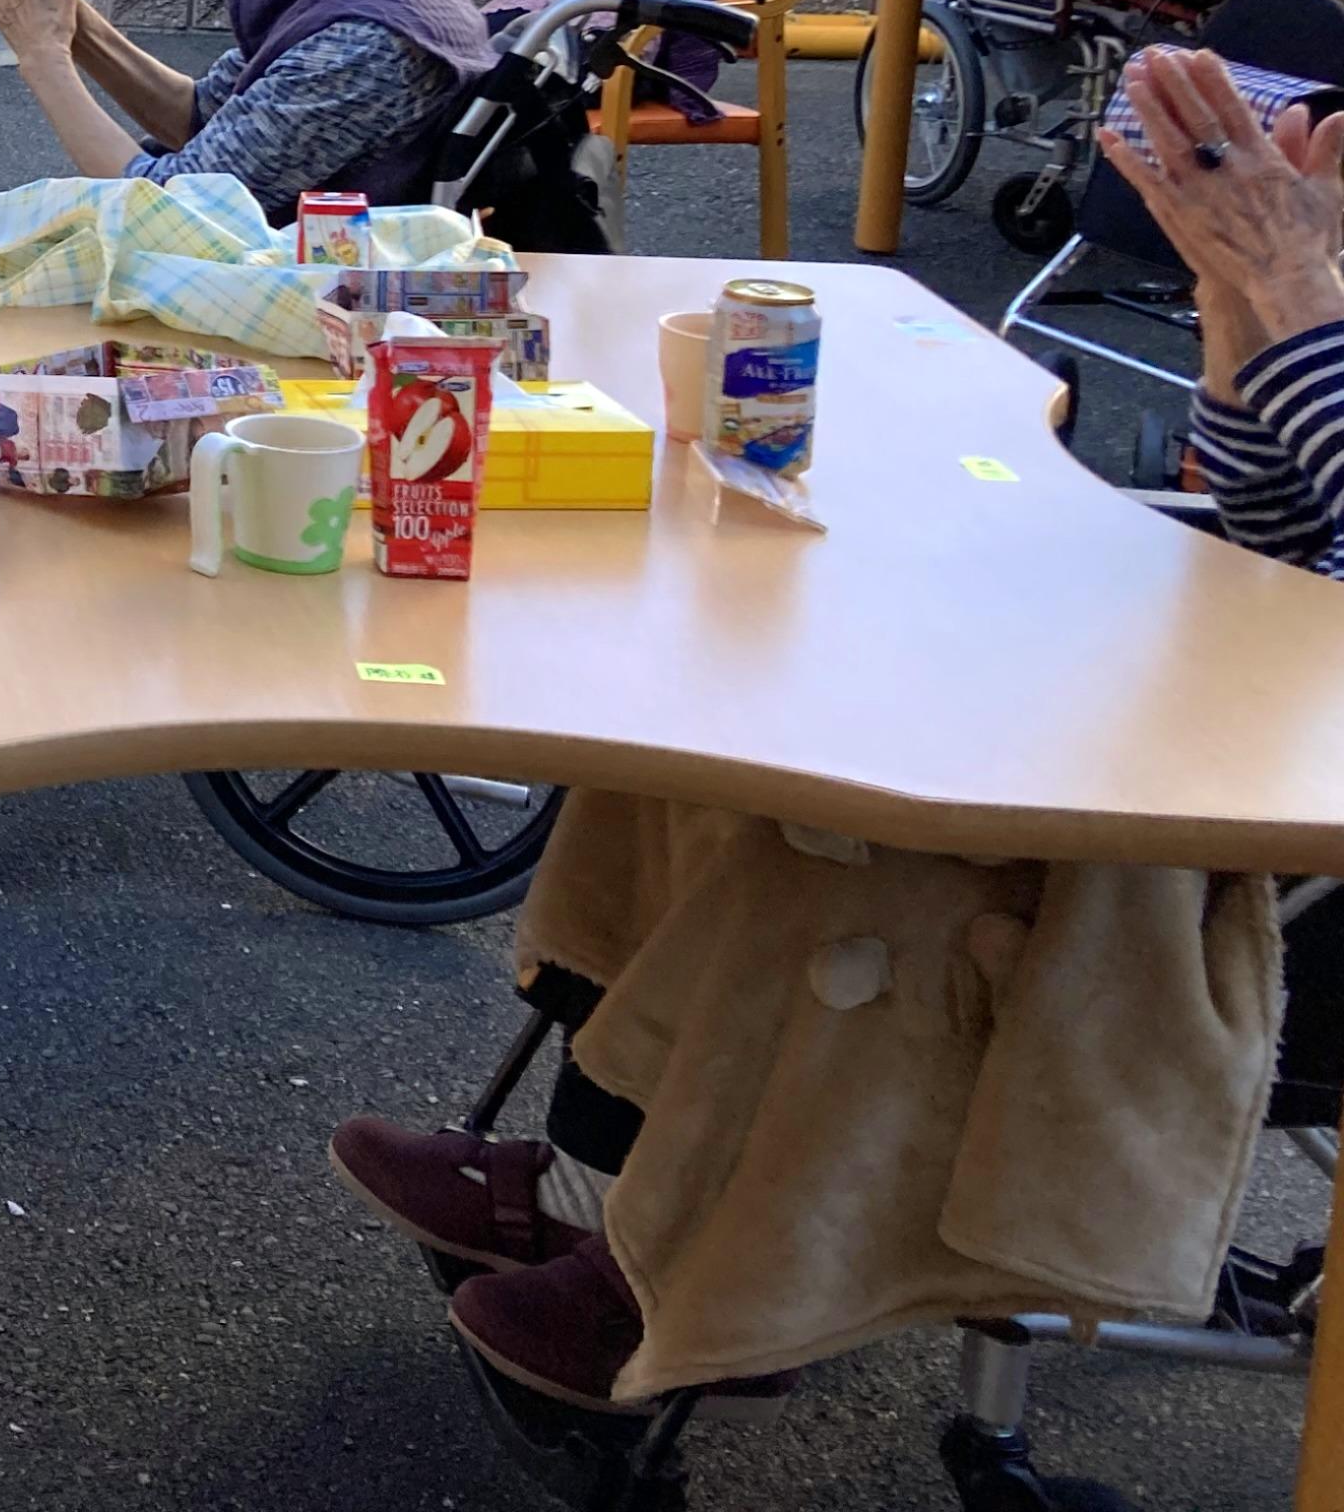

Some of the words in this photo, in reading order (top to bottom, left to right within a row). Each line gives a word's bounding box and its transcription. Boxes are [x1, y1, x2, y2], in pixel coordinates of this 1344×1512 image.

[394, 483, 443, 501] FRUITS
[393, 498, 470, 518] SELECTION
[392, 514, 430, 541] 100
